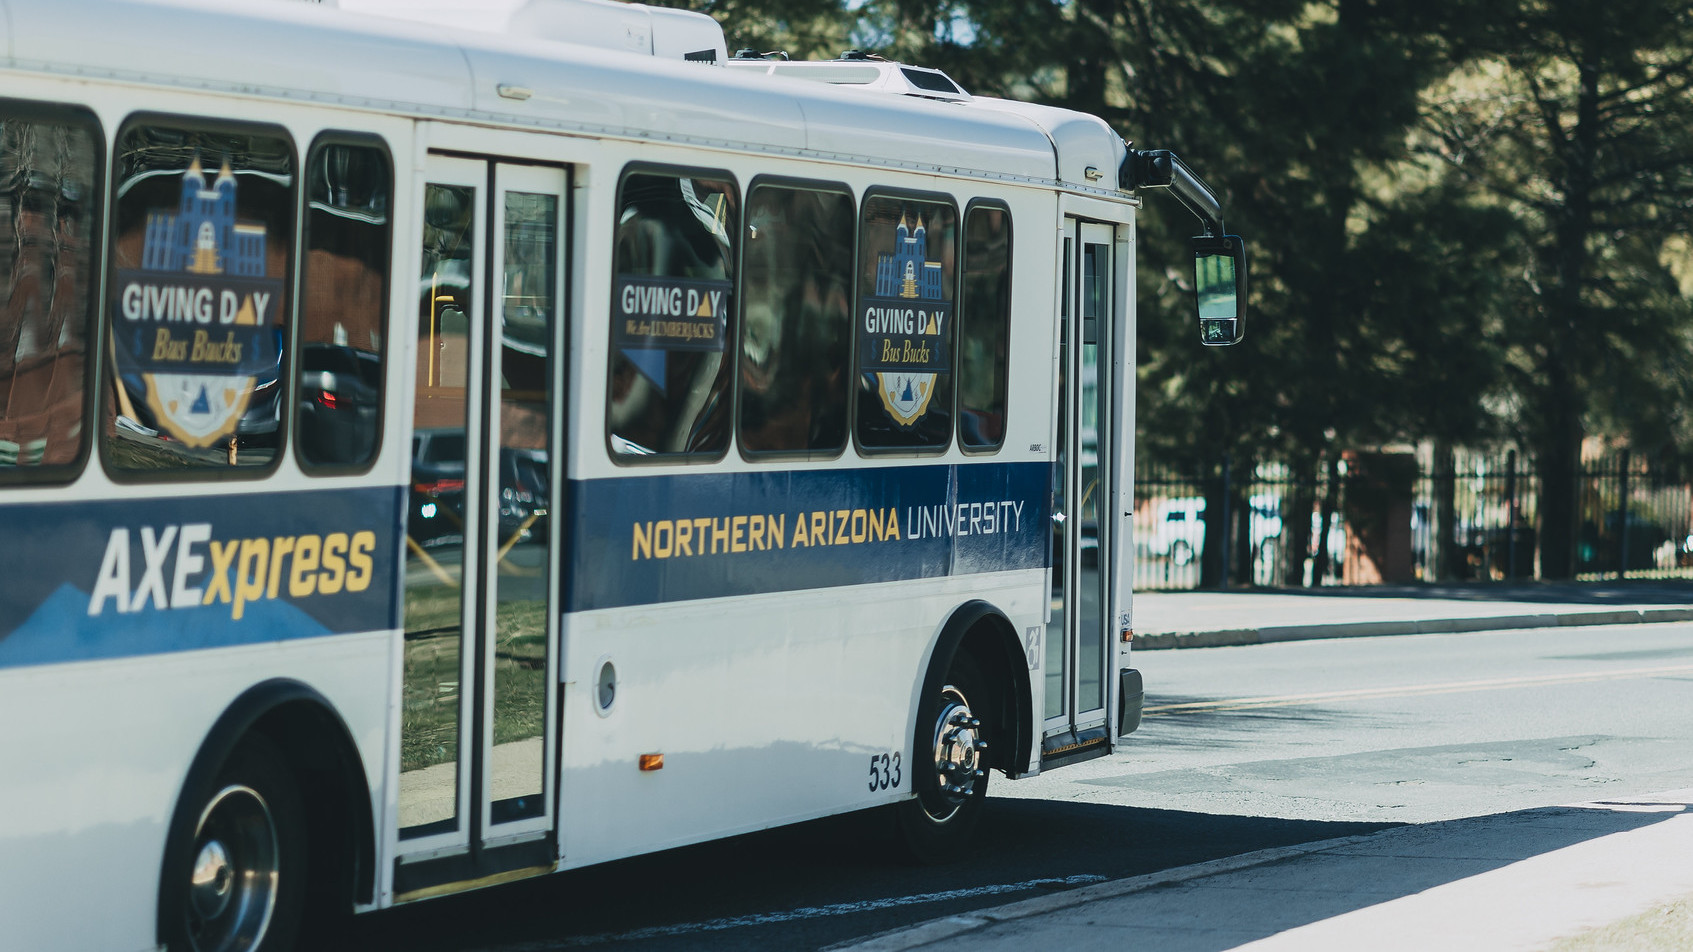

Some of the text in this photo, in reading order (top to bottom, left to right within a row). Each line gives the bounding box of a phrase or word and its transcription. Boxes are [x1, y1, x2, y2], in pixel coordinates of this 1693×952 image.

[122, 283, 271, 326] GIVING DAY
[622, 285, 721, 318] GIVING DAY
[865, 306, 944, 336] GIVING DAY
[152, 328, 243, 363] Bus Bucks
[881, 339, 930, 363] Bus Bucks
[631, 500, 1025, 560] NORTHERN ARIZONA UNIVERSITY
[87, 523, 376, 620] AXExpress
[868, 751, 902, 792] 533
